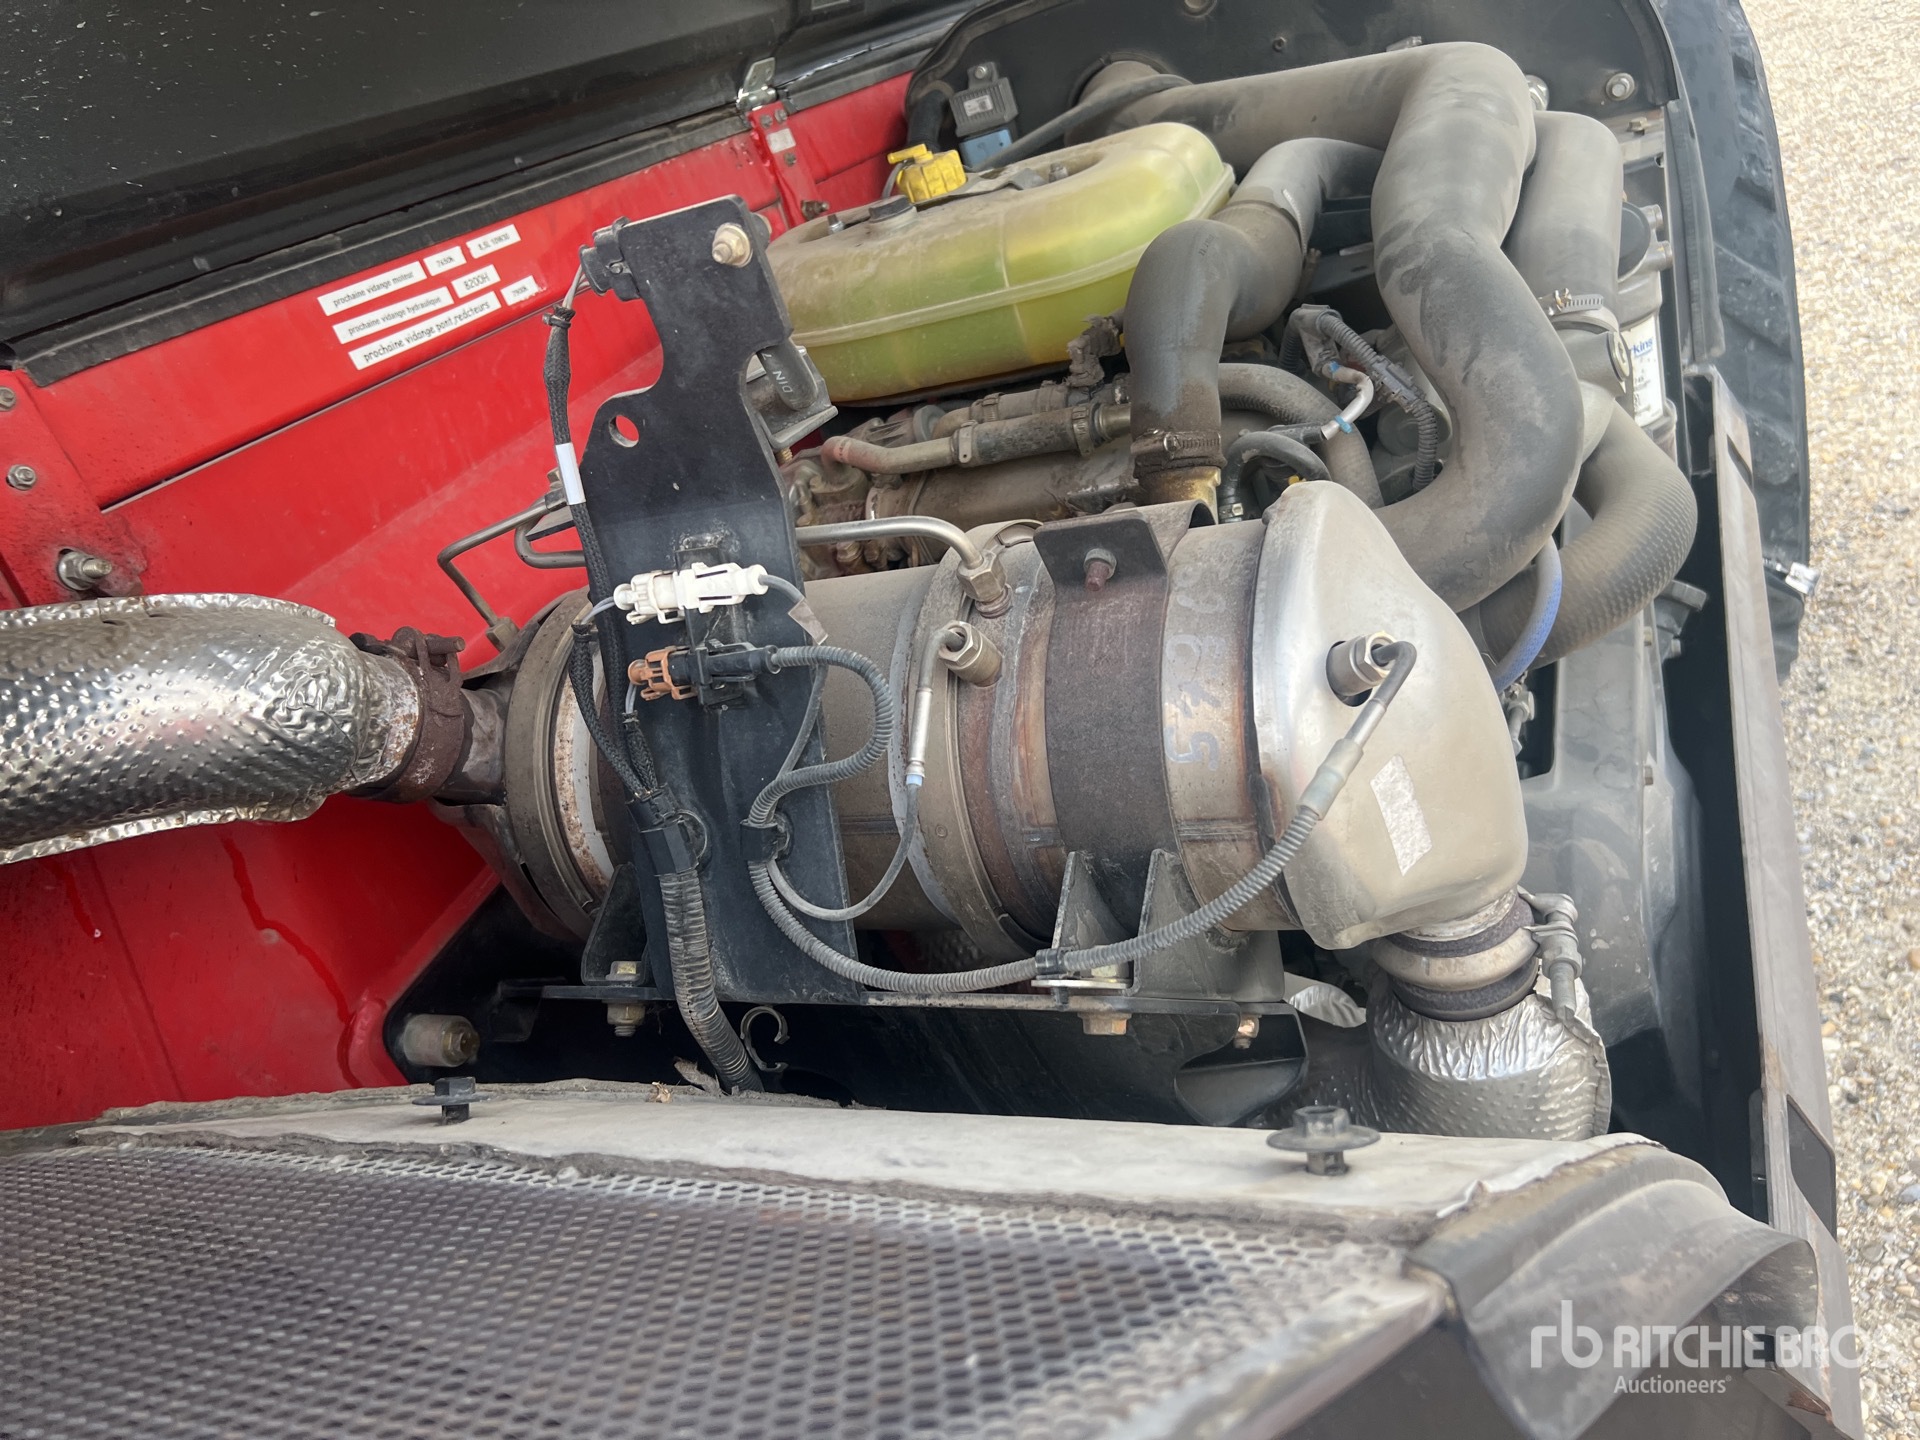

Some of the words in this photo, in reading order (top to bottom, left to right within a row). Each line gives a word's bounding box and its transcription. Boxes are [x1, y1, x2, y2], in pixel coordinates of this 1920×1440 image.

[333, 289, 366, 307] prochaine
[366, 279, 392, 294] vidange
[392, 271, 414, 285] moteur
[463, 271, 490, 290] 8200H
[348, 318, 381, 336] prochaine
[381, 309, 407, 323] vidange
[406, 297, 442, 314] hydraulique
[363, 339, 405, 363] prochaine
[405, 326, 436, 343] vidange
[772, 370, 793, 393] DIN
